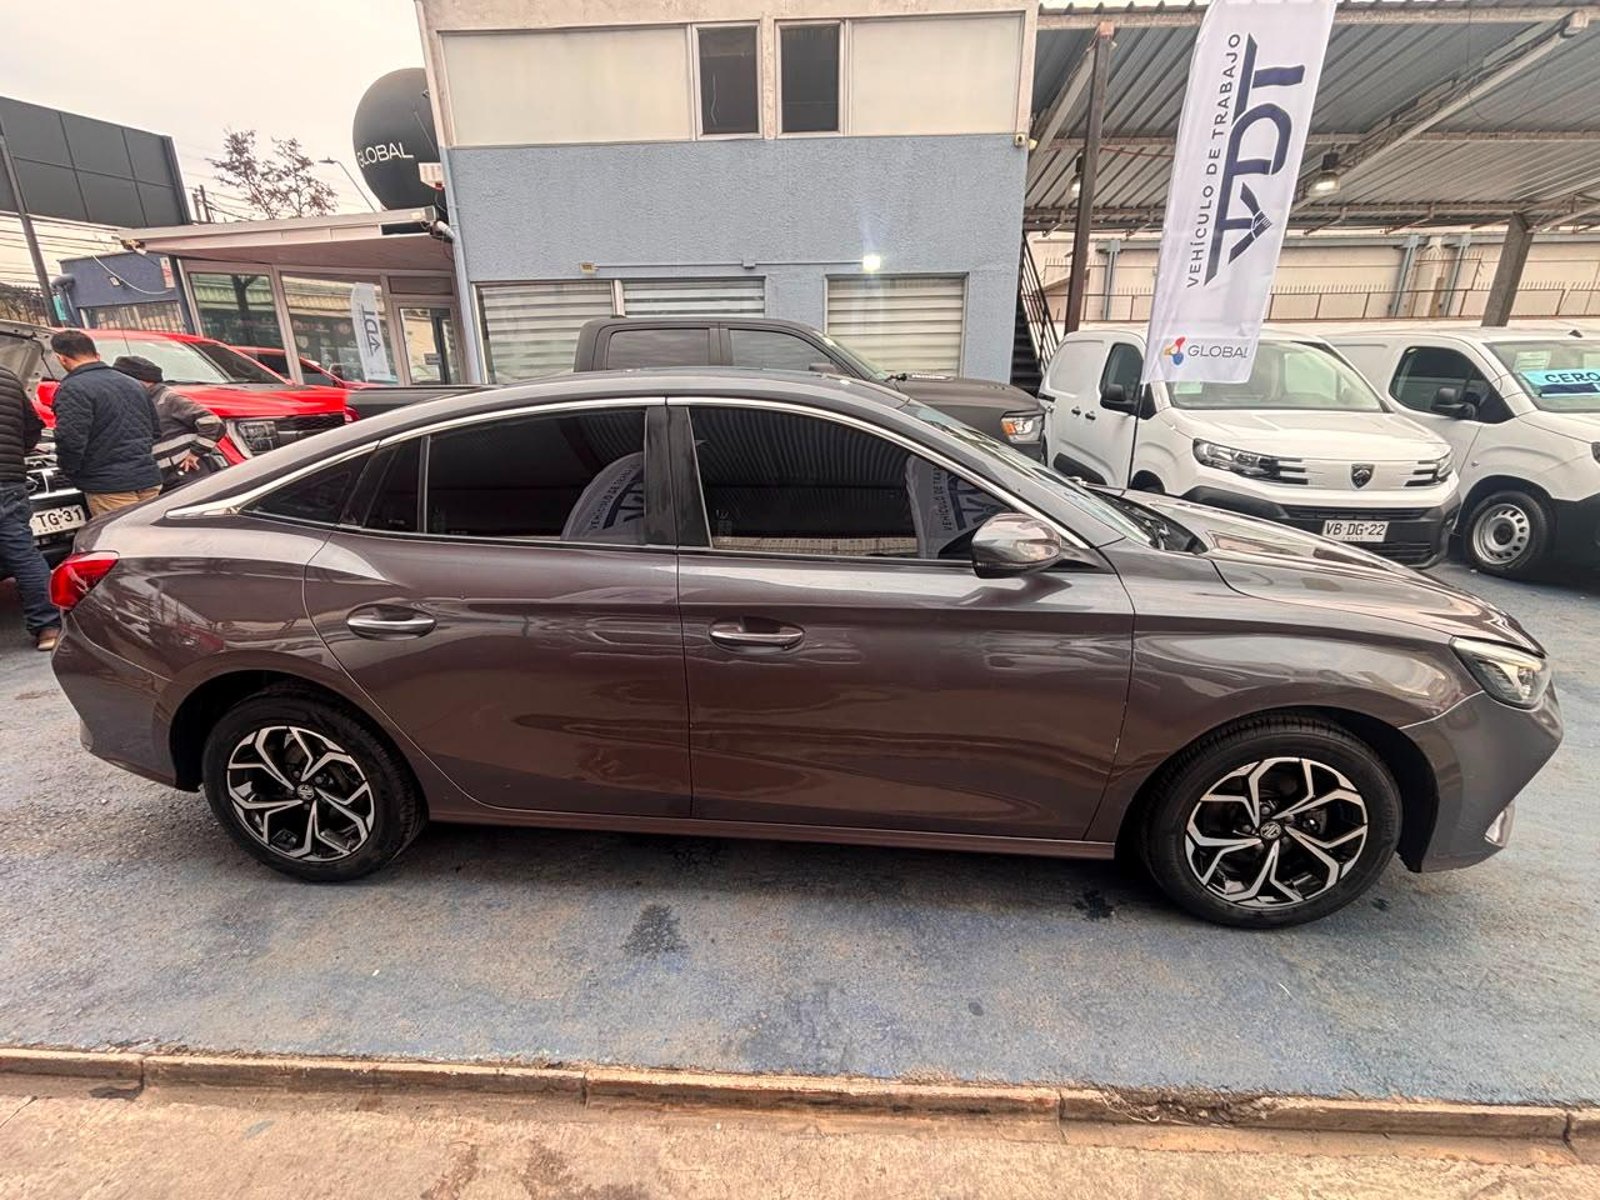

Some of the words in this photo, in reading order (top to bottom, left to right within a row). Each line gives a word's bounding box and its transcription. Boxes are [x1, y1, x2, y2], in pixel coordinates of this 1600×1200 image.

[1211, 33, 1241, 140] TRABAJO
[357, 142, 414, 169] GLOBAL
[1206, 148, 1221, 175] DE
[1187, 185, 1214, 288] VEHÍCULO
[1187, 344, 1249, 359] GLOBAL
[1545, 372, 1600, 383] CERO
